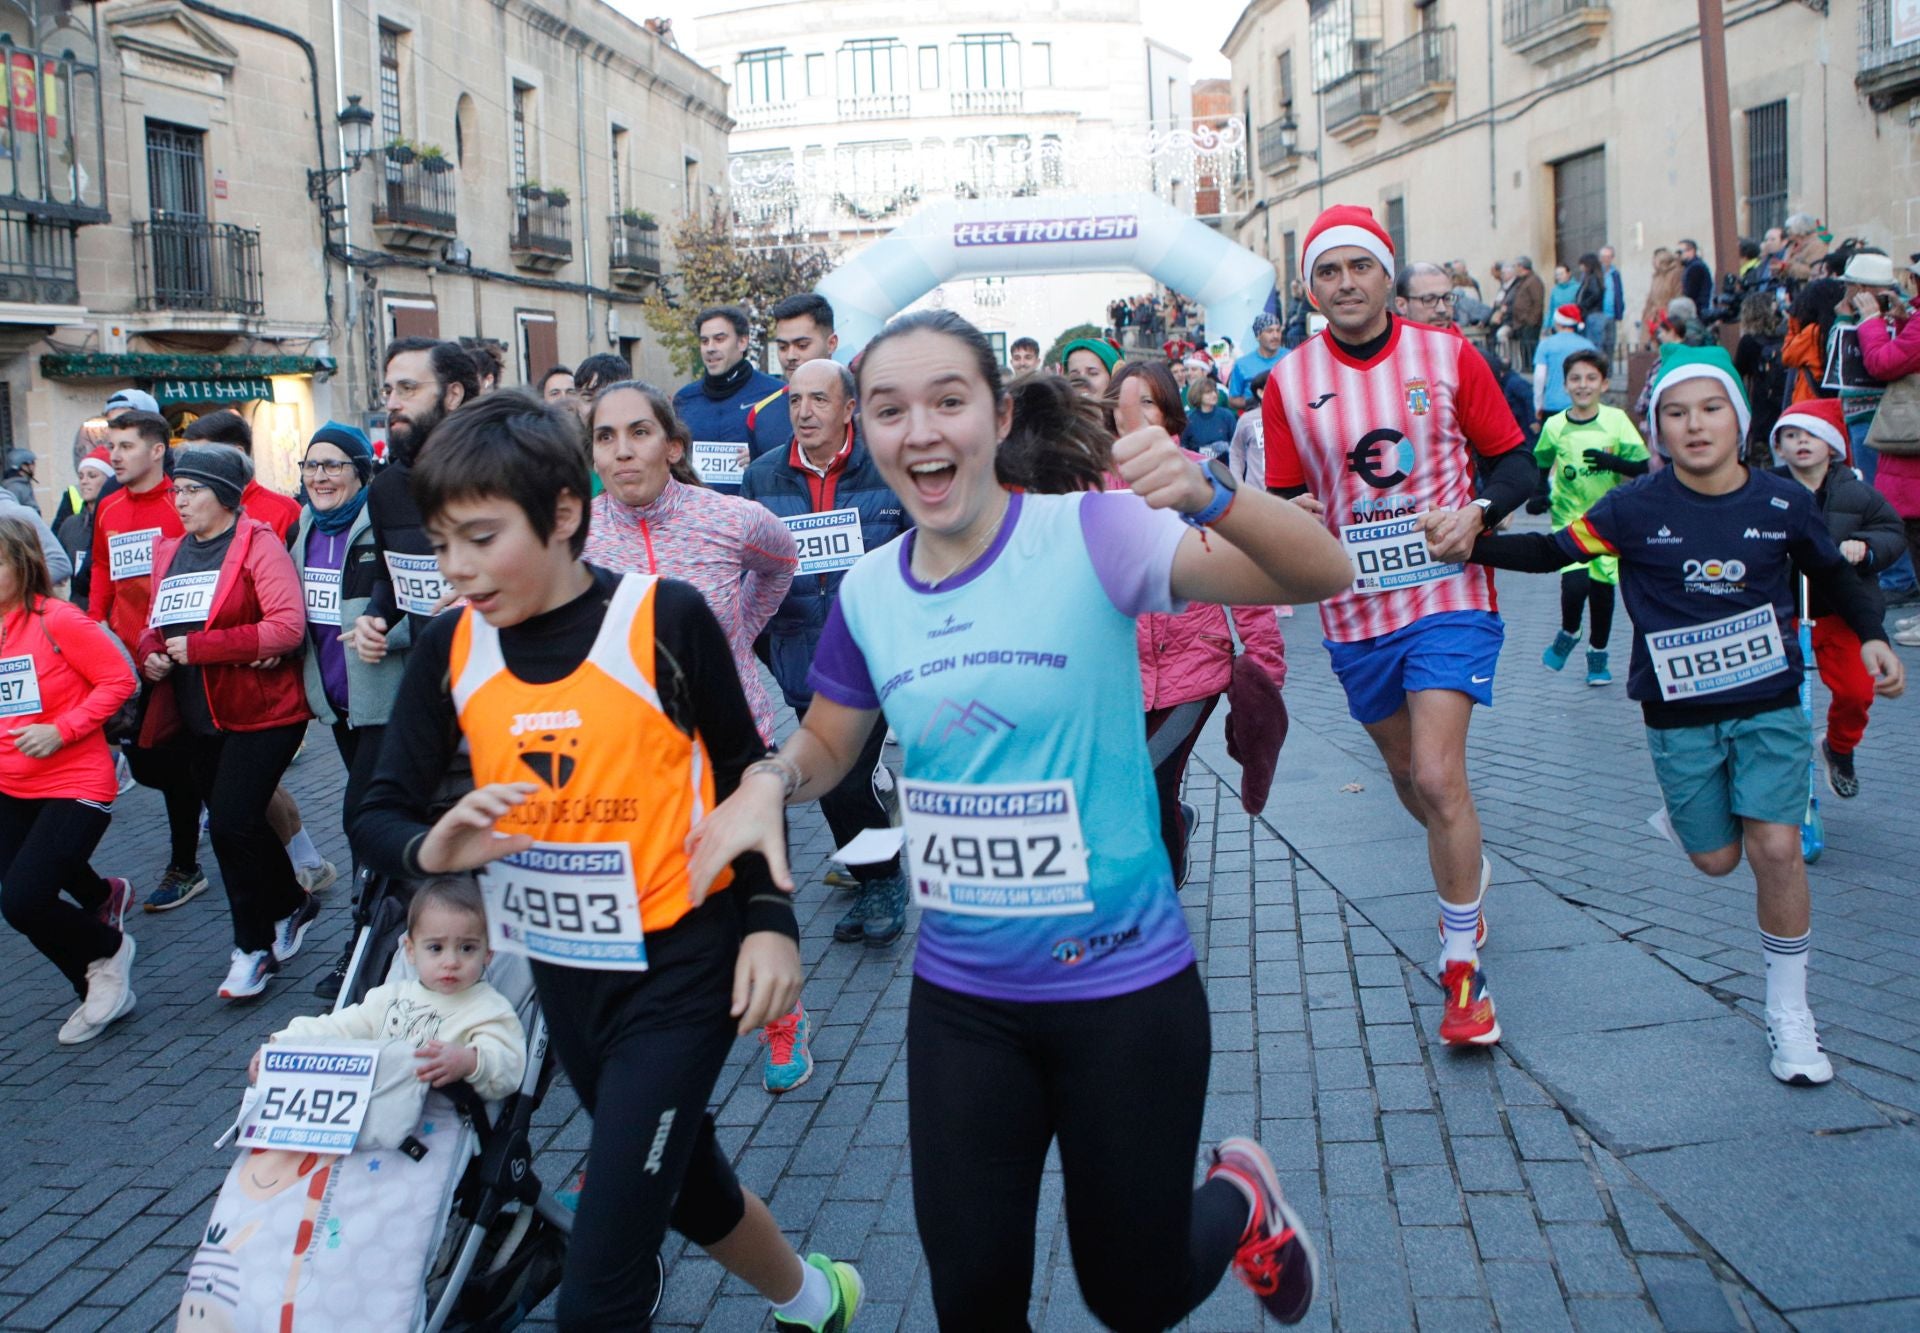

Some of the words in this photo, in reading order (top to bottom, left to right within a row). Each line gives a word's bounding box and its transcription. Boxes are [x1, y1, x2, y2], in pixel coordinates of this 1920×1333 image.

[957, 216, 1136, 245] ELECTROCASH
[164, 381, 269, 399] ARTESANIA
[696, 445, 739, 453] ELECTROCAS
[701, 457, 739, 473] 2912
[1352, 495, 1417, 513] ahorro
[784, 513, 856, 532] LECTROCASH
[1353, 506, 1417, 525] pymes
[797, 533, 850, 559] 2910
[1647, 536, 1683, 544] Santander
[1357, 541, 1427, 575] 086
[161, 575, 216, 591] ELECTROCASH
[1417, 569, 1430, 579] SAN
[160, 591, 204, 612] 0510
[308, 589, 340, 610] 051
[1657, 612, 1769, 648] ELECTROCASH
[920, 657, 956, 677] CON
[962, 651, 1067, 669] NOSOTRAS
[1667, 635, 1772, 679] 0859
[0, 680, 24, 701] 97
[550, 799, 570, 823] DE
[907, 791, 1066, 816] ELECTROCASH
[922, 833, 1067, 879] 4992
[503, 882, 623, 934] 4993
[266, 1054, 372, 1074] ELECTROCASH
[260, 1087, 358, 1126] 5492
